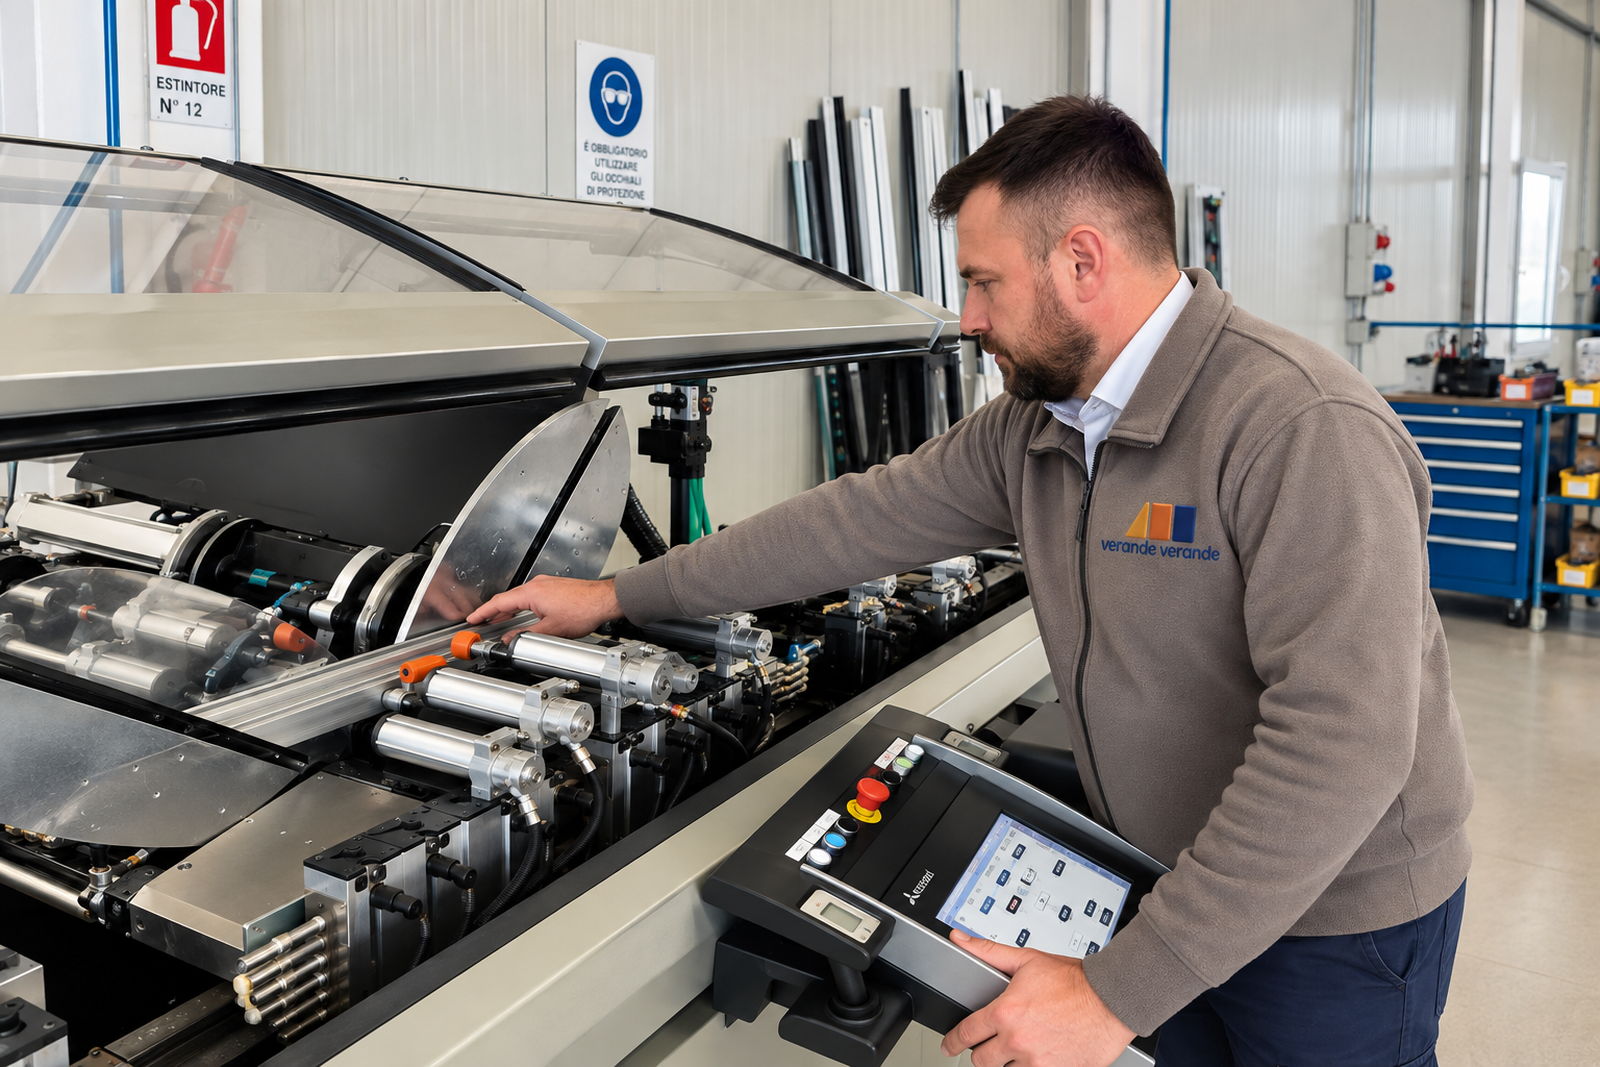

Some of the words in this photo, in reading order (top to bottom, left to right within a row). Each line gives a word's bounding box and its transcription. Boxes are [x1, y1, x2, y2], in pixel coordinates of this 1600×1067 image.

[156, 76, 226, 97] ESTINTORE
[185, 101, 202, 117] 12
[591, 143, 648, 159] OBBLIGATORIO
[595, 158, 638, 172] UTILIZZARE
[591, 171, 603, 182] GLI
[605, 173, 642, 186] OCCHIALI
[587, 185, 595, 196] DI
[597, 186, 645, 200] PROTEZIONE
[1101, 539, 1157, 556] verande
[1160, 545, 1220, 561] verande
